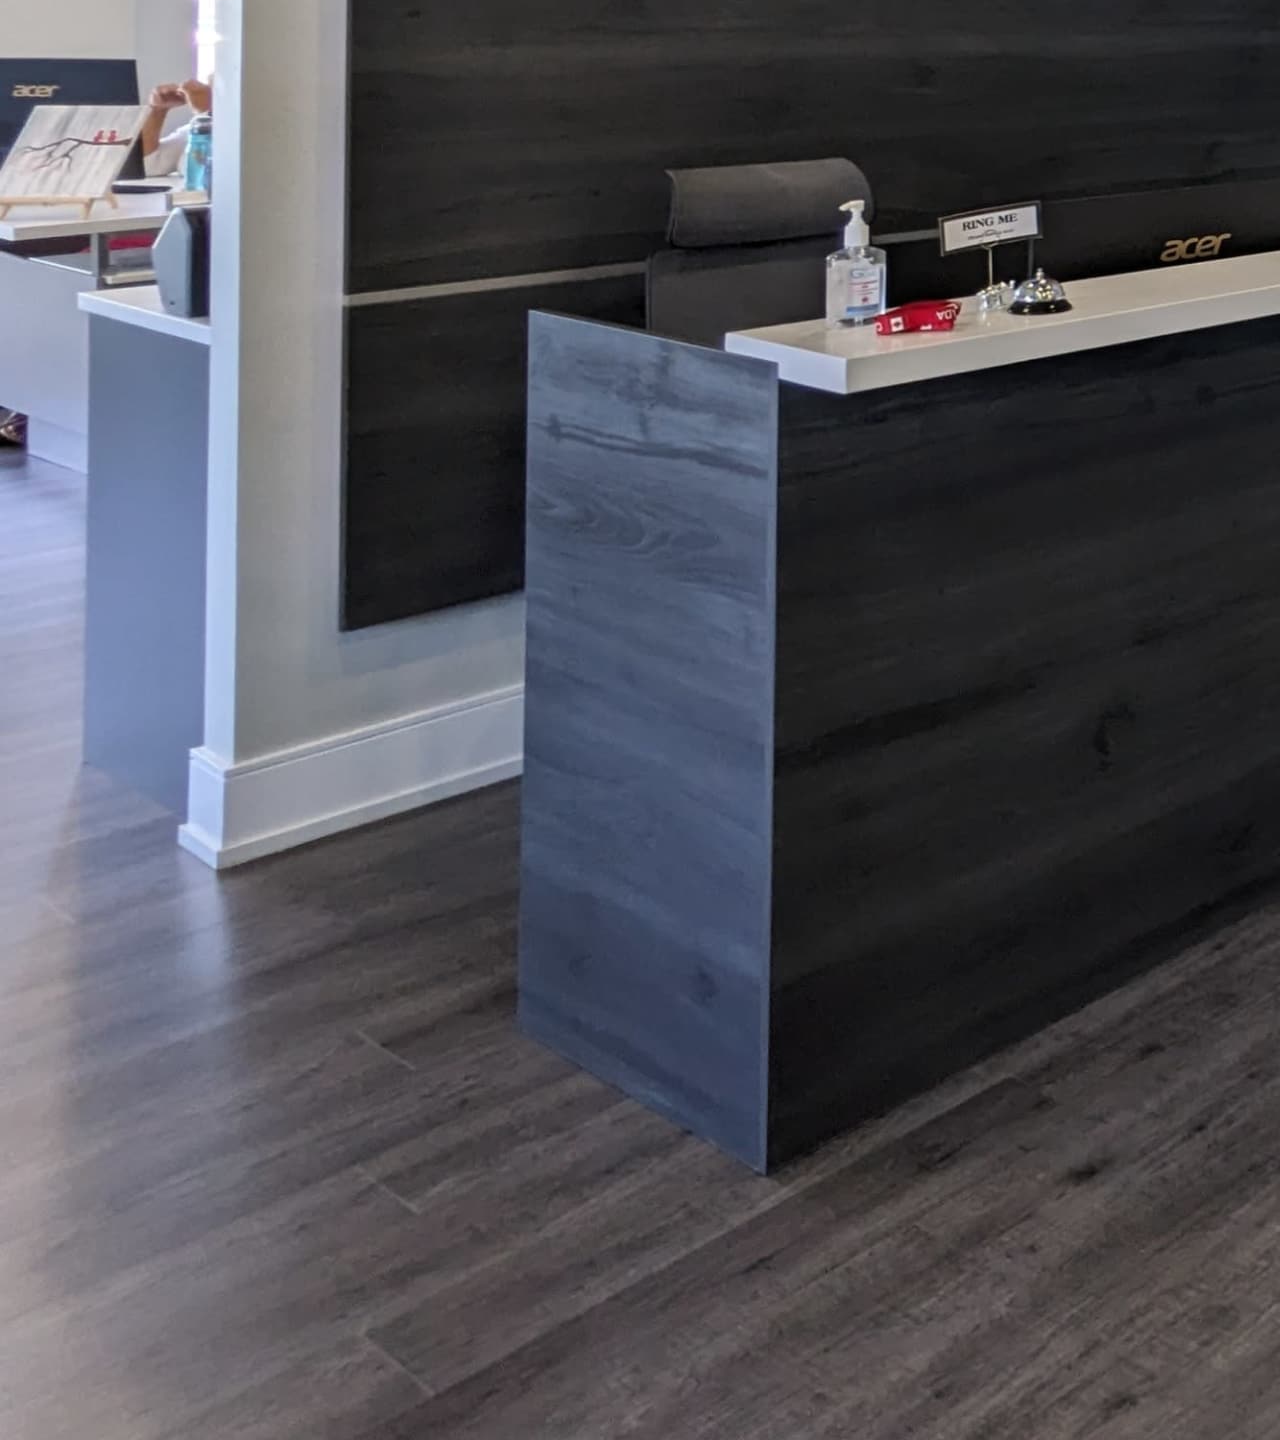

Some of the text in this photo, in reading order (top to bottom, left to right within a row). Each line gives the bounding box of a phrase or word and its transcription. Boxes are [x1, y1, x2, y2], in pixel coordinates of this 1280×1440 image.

[12, 84, 60, 97] acer
[962, 213, 1018, 231] RING ME
[1160, 233, 1232, 262] acer
